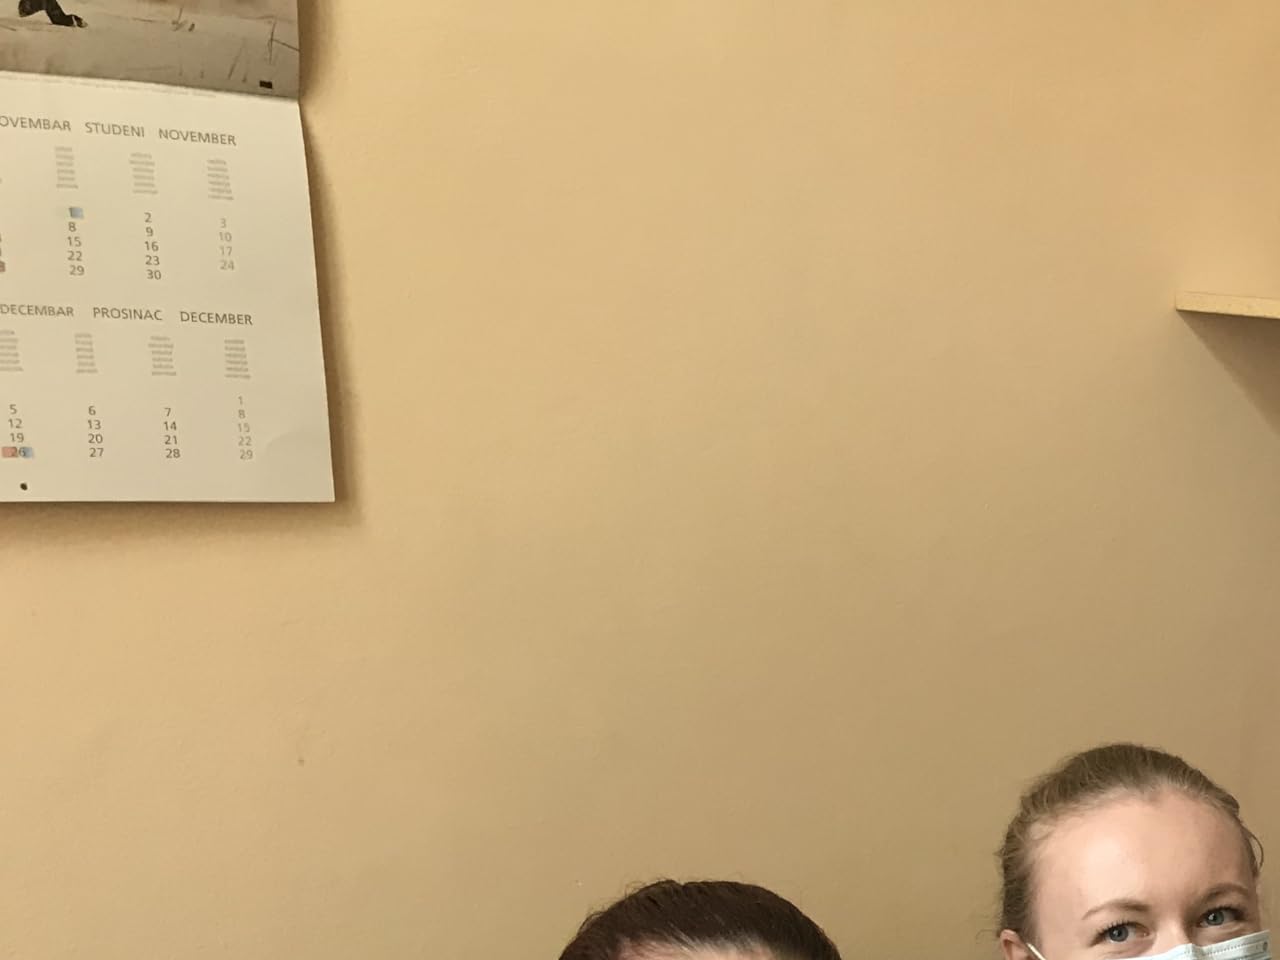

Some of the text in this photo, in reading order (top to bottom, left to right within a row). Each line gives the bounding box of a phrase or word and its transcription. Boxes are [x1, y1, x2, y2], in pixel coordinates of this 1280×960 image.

[85, 121, 145, 138] STUDENI
[158, 128, 237, 146] NOVEMBER
[144, 212, 152, 223] 2
[220, 218, 227, 228] 3
[68, 221, 232, 242] 8 9 10
[67, 236, 233, 257] 15 16 17
[67, 250, 235, 271] 22 23 24
[69, 264, 162, 280] 29 30
[0, 303, 253, 326] DECEMBAR PROSINAC DECEMBER
[9, 404, 18, 415] 5
[88, 405, 96, 416] 6
[164, 407, 172, 417] 7
[8, 418, 22, 429] 12
[87, 419, 102, 430] 13
[164, 421, 177, 431] 14
[10, 432, 25, 443] 19
[88, 433, 103, 444] 20
[164, 435, 178, 445] 21
[90, 447, 104, 458] 27
[166, 448, 181, 459] 28
